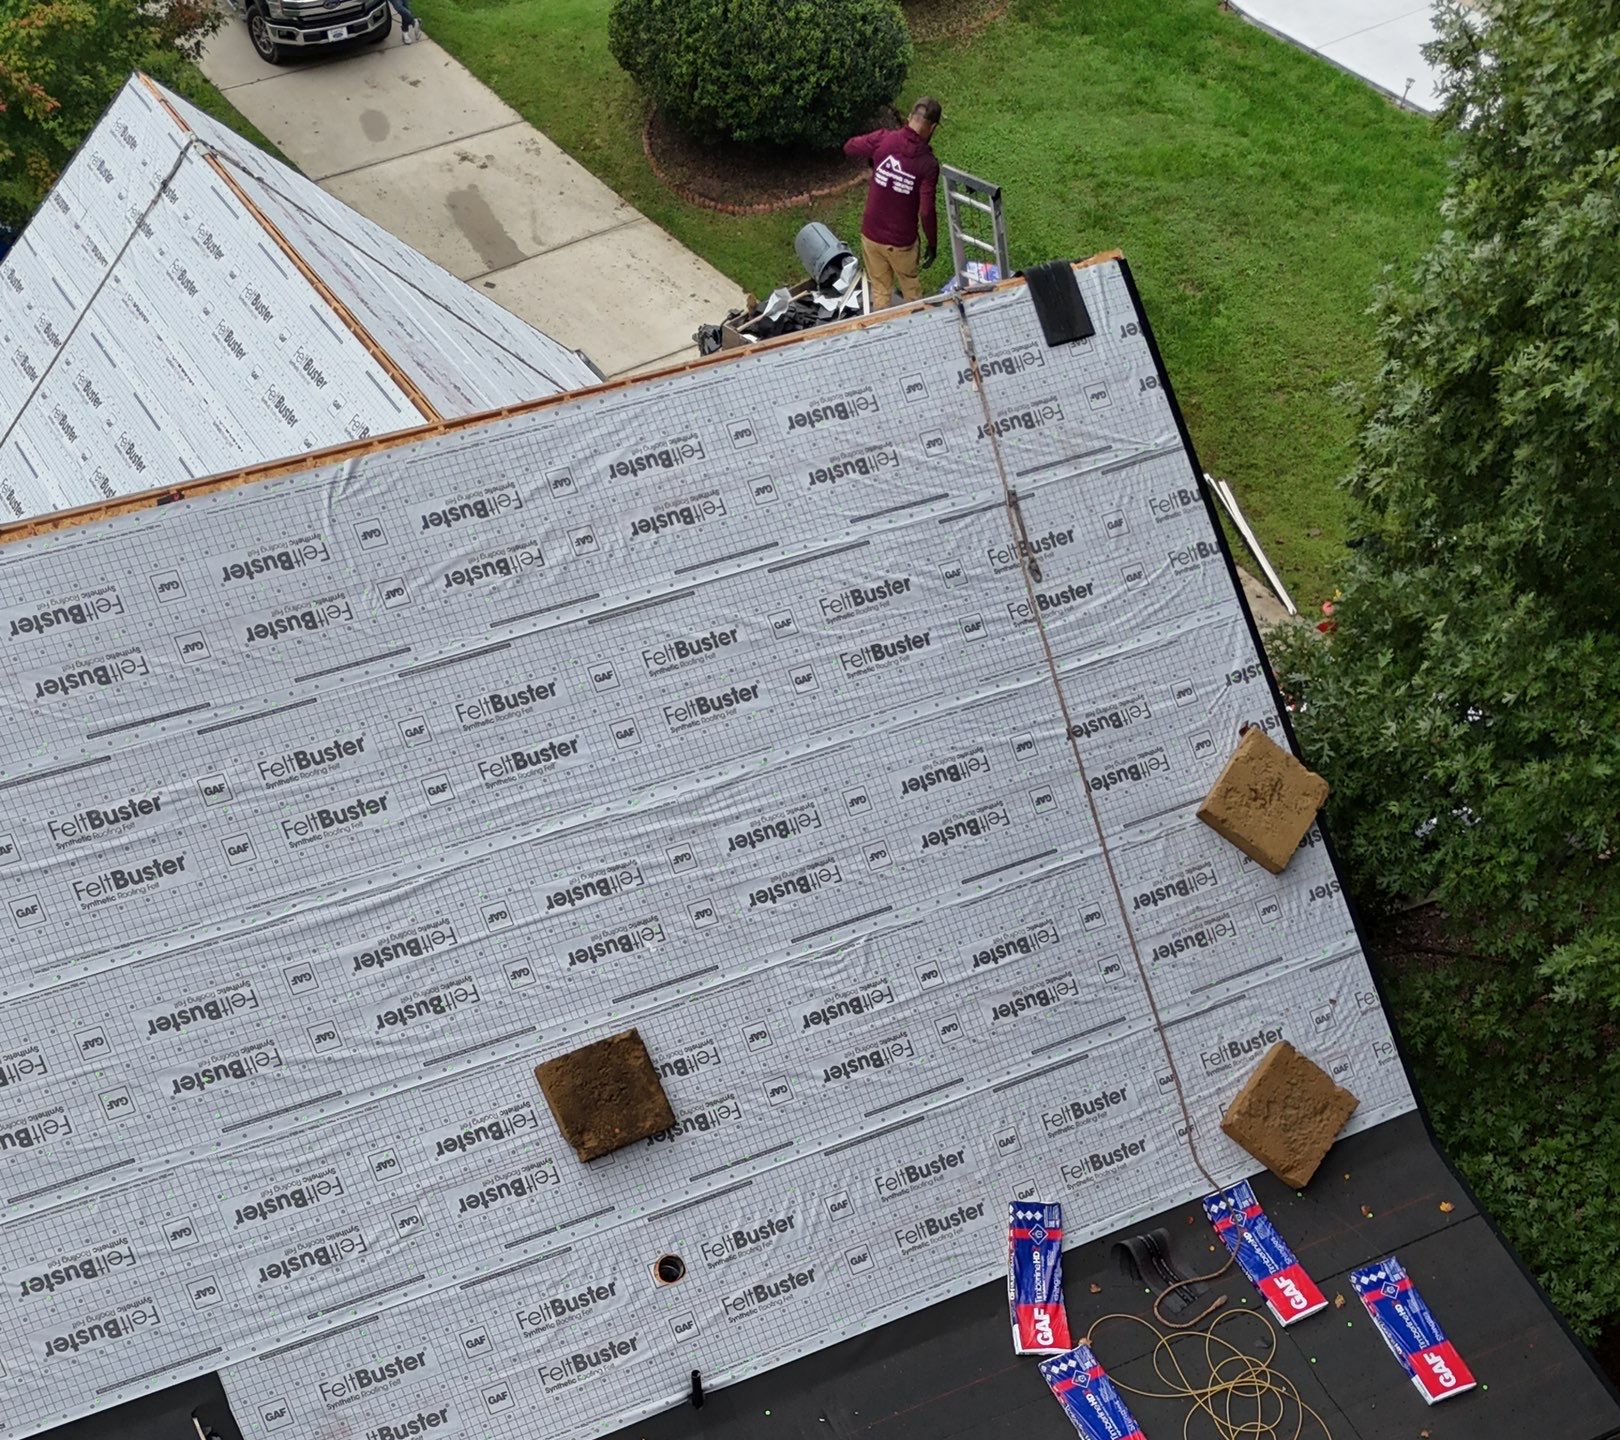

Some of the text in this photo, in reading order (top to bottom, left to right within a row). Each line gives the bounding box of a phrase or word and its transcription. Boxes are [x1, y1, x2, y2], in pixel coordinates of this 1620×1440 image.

[906, 382, 923, 392] GAF
[733, 429, 751, 440] GAF
[1107, 519, 1123, 529] GAF
[575, 535, 593, 546] GAF
[945, 568, 962, 579] GAF
[1006, 582, 1094, 620] FelBuster
[183, 641, 204, 654] GAF
[594, 671, 613, 682] GAF
[1176, 688, 1192, 698] GAF
[1016, 741, 1032, 751] GAF
[204, 783, 226, 796] GAF
[1035, 793, 1052, 804] GAF
[672, 852, 691, 864] GAF
[487, 910, 507, 922] GAF
[1084, 911, 1100, 922] GAF
[510, 967, 529, 979] GAF
[1103, 964, 1120, 975] GAF
[940, 1022, 958, 1033] GAF
[314, 1030, 336, 1043] GAF
[769, 1085, 788, 1096] GAF
[375, 1159, 395, 1171] GAF
[831, 1201, 848, 1212] GAF
[398, 1215, 418, 1228] GAF
[170, 1227, 192, 1240] GAF
[850, 1253, 868, 1264] GAF
[194, 1285, 216, 1299] GAF
[1273, 1277, 1307, 1309] GAF
[675, 1320, 694, 1333] GAF
[1034, 1308, 1053, 1345] GAF
[466, 1335, 486, 1348] GAF
[1423, 1352, 1456, 1387] GAF
[487, 1391, 509, 1404] GAF
[266, 1408, 287, 1421] GAF
